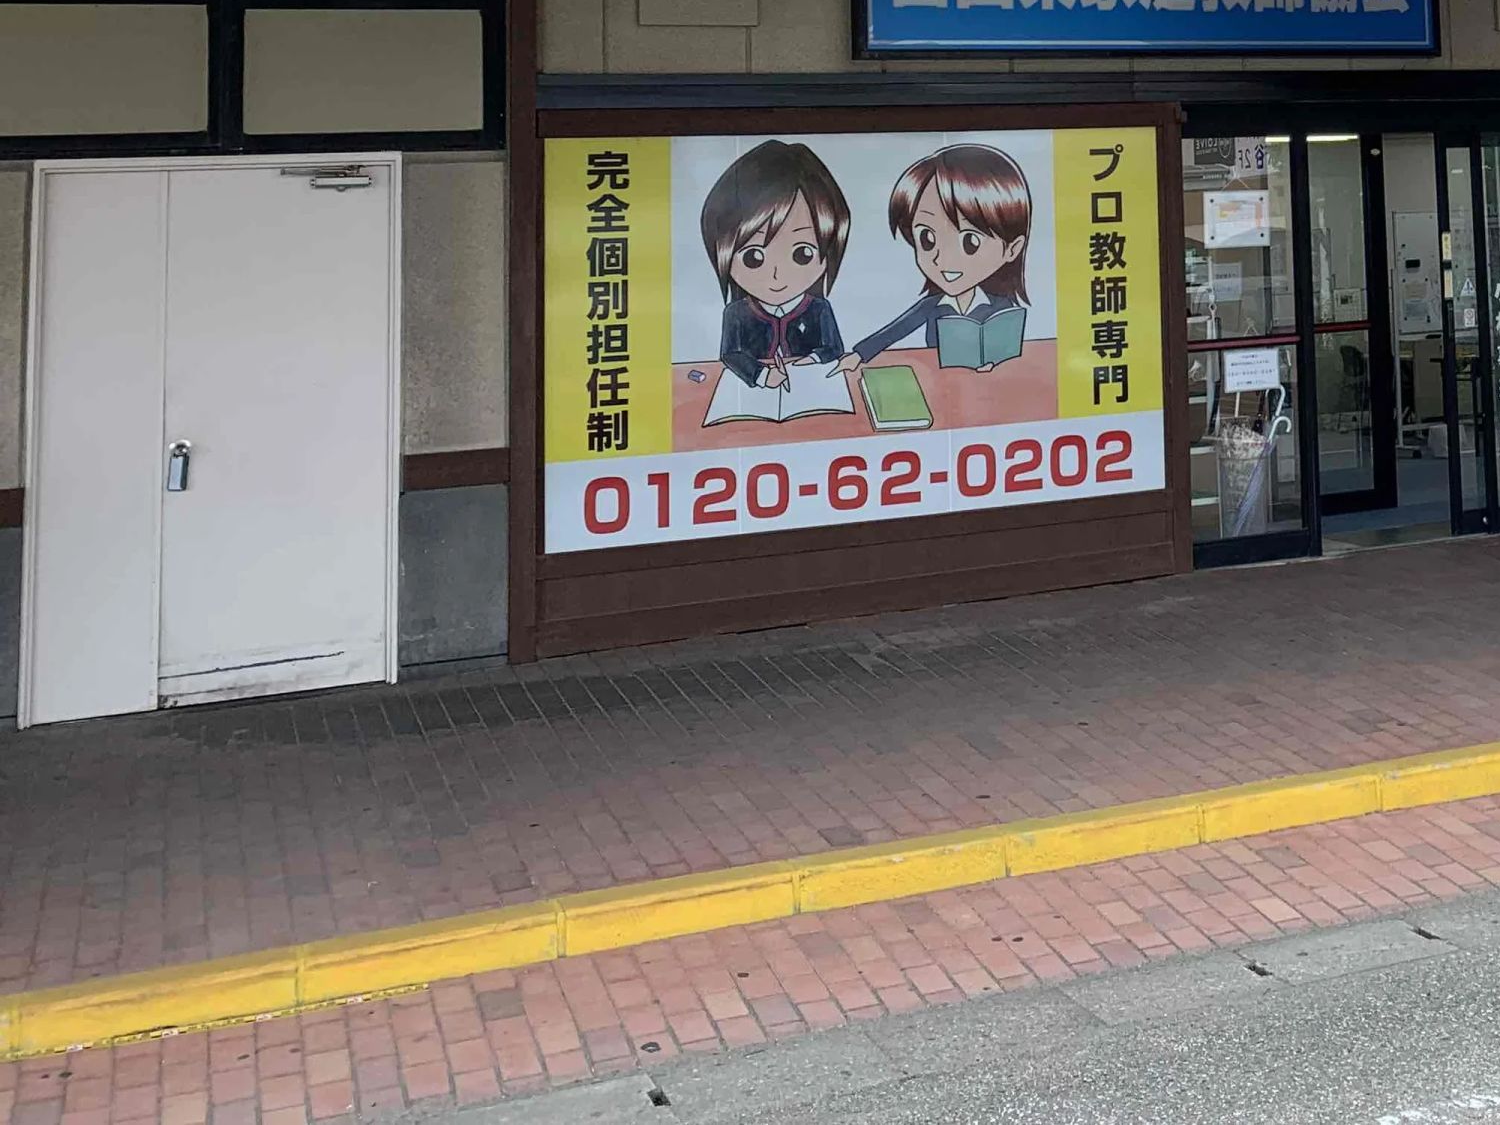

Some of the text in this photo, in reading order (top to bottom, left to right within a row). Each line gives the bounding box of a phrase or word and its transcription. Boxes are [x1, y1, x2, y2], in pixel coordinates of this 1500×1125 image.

[584, 150, 631, 453] 完全個別担任制
[1088, 143, 1131, 406] プロ教師専門
[583, 428, 1134, 536] 0120-62-0202
